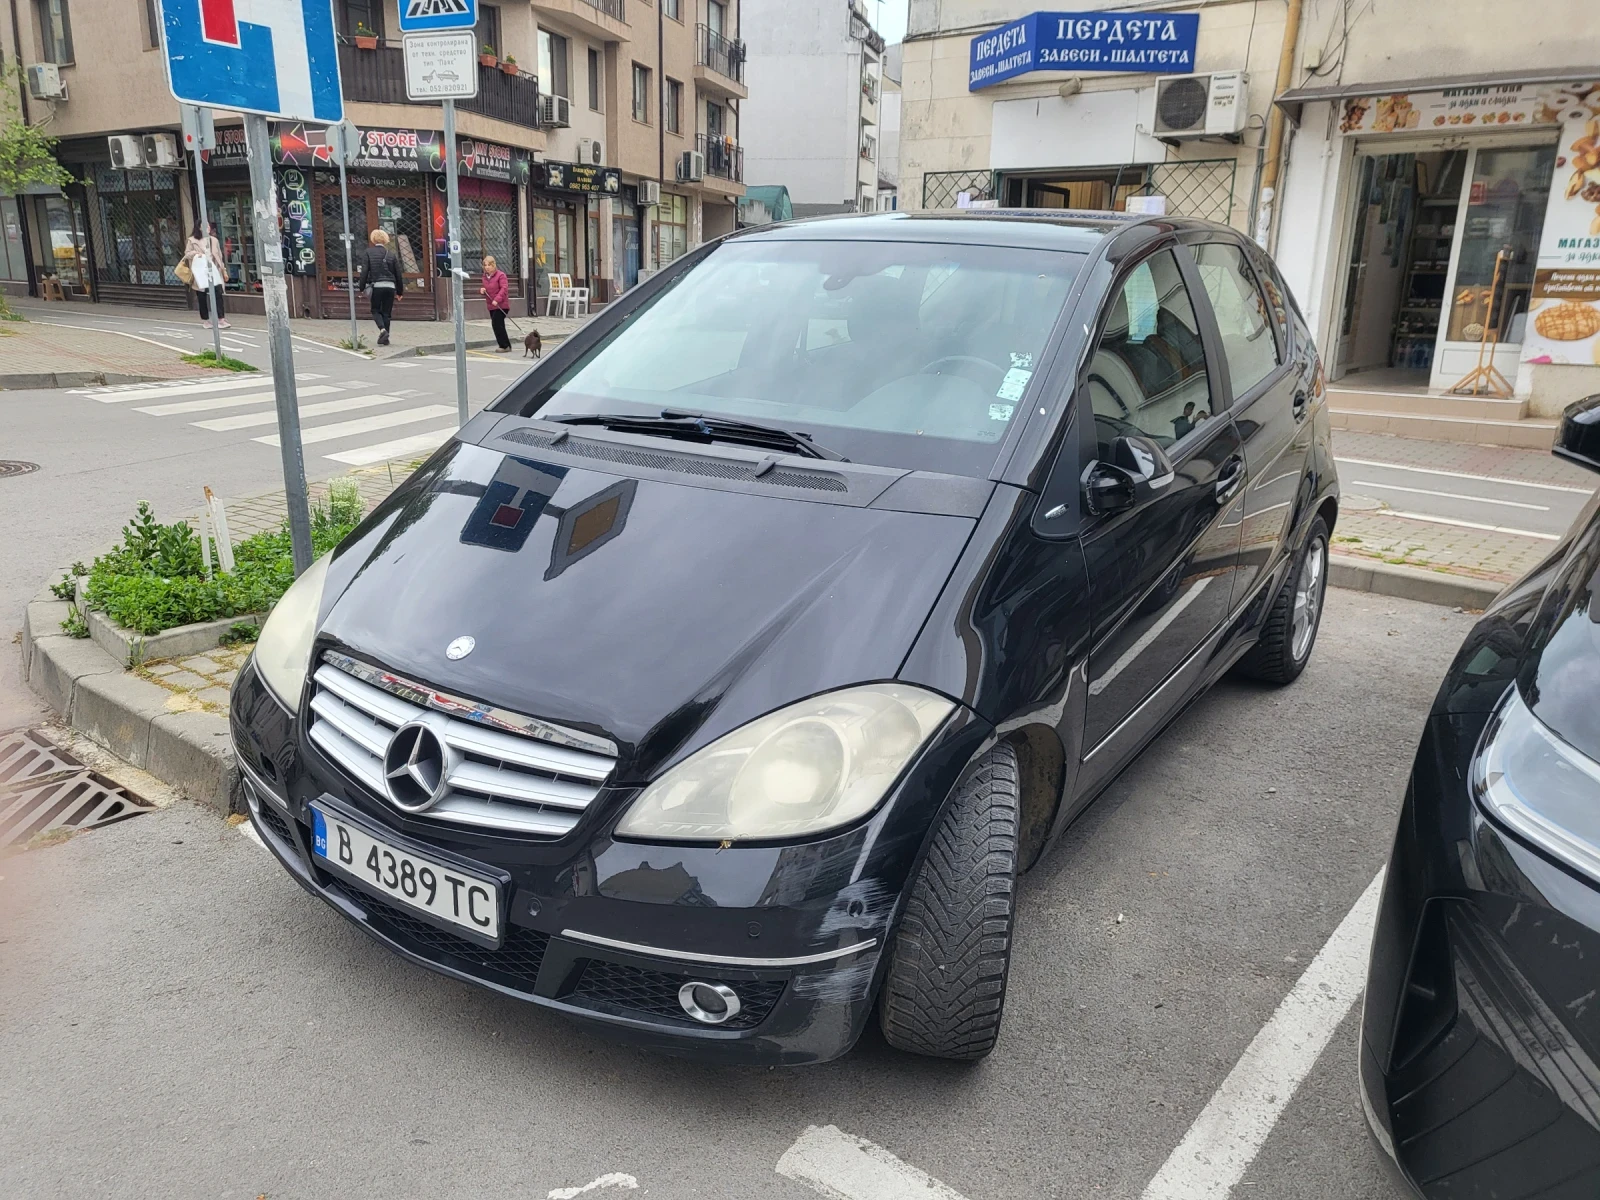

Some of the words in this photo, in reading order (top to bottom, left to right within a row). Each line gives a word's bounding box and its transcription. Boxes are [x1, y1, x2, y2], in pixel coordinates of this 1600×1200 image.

[1056, 19, 1178, 44] ПЕРДЕТА
[409, 40, 424, 48] Зона
[427, 39, 468, 47] контролирана
[976, 24, 1027, 61] ПЕРДЕТА
[439, 49, 467, 57] средство
[1039, 48, 1100, 63] ЗАВЕСИ
[1110, 49, 1189, 64] ШАЛТЕТА
[367, 132, 418, 148] STORE
[360, 146, 418, 158] LGARIA
[488, 144, 510, 160] STORE
[315, 835, 326, 850] BG
[336, 824, 353, 865] B
[366, 844, 437, 906] 4389
[444, 874, 491, 927] TC
